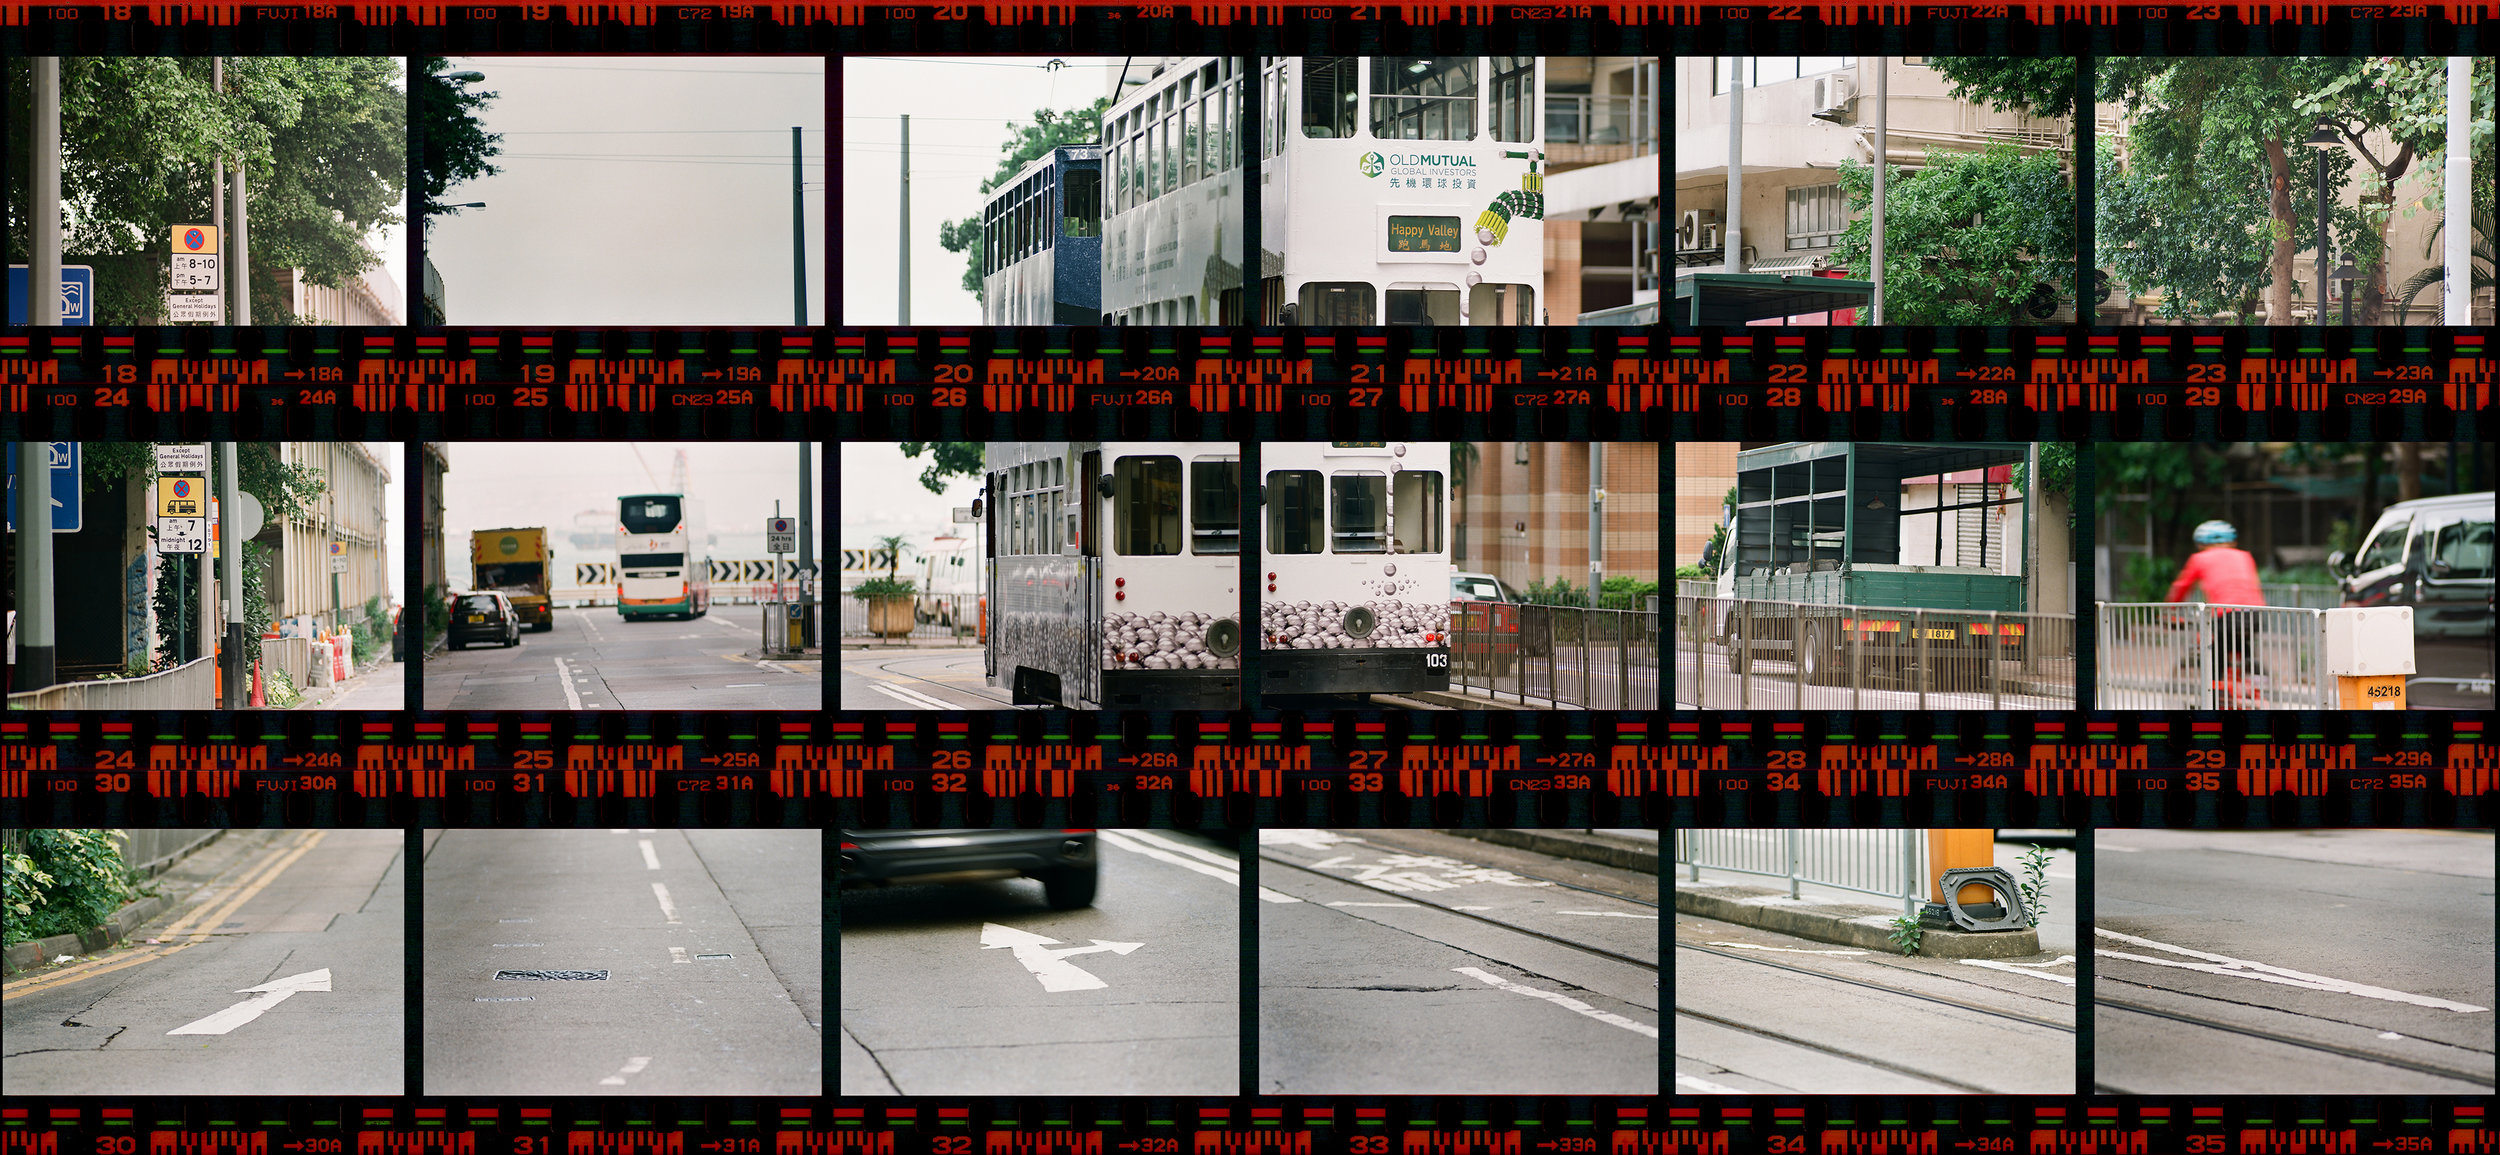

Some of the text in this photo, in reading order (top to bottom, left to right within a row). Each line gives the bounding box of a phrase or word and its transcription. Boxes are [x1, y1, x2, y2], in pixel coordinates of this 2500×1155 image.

[49, 8, 78, 20] 100
[100, 3, 131, 20] 18
[257, 4, 337, 19] FUJI 18A
[467, 8, 496, 19] 100
[519, 3, 549, 20] 19
[679, 4, 754, 19] C72 19A
[886, 8, 915, 19] 100
[933, 3, 968, 20] 20
[1137, 4, 1173, 18] 20A
[1303, 8, 1332, 19] 100
[1350, 3, 1381, 20] 21
[1511, 4, 1591, 19] CN23 21A
[1720, 8, 1749, 19] 100
[1768, 3, 1802, 20] 22
[1928, 4, 2008, 19] FUJI 22A
[2139, 8, 2167, 19] 100
[2186, 3, 2220, 20] 23
[2351, 4, 2427, 18] C72 23A
[1071, 149, 1088, 160] 73
[1390, 154, 1476, 167] OLDMUTUAL
[1430, 168, 1476, 176] INVESTORS
[1390, 177, 1476, 189] 先機環球投資
[1392, 224, 1459, 239] Happy Valley
[1398, 239, 1453, 251] 跑馬地
[189, 259, 216, 269] 8-10
[102, 365, 136, 383] 18
[309, 367, 342, 381] 18A
[521, 365, 554, 384] 19
[727, 367, 761, 381] 19A
[934, 364, 973, 383] 20
[1142, 367, 1179, 380] 20A
[1351, 364, 1384, 383] 21
[1559, 367, 1596, 380] 21A
[1768, 364, 1807, 383] 22
[1978, 366, 2015, 380] 22A
[2187, 364, 2226, 383] 23
[2395, 366, 2432, 380] 23A
[47, 394, 76, 406] 100
[95, 388, 129, 407] 24
[300, 390, 336, 404] 24A
[465, 394, 495, 405] 100
[513, 388, 548, 406] 25
[672, 390, 753, 405] CN23 25A
[884, 394, 914, 405] 100
[932, 387, 967, 406] 26
[1091, 390, 1172, 405] FUJI 26A
[1302, 394, 1330, 406] 100
[1349, 388, 1383, 407] 27
[1515, 390, 1590, 406] C72 27A
[1719, 394, 1748, 405] 100
[1767, 387, 1801, 406] 28
[1970, 389, 2007, 404] 28A
[2138, 394, 2167, 405] 100
[2185, 387, 2220, 406] 29
[2345, 389, 2426, 405] CN23 29A
[187, 520, 196, 532] 7
[188, 539, 202, 551] 12
[1425, 653, 1448, 668] 103
[2368, 686, 2401, 697] 45218
[96, 750, 135, 769] 24
[305, 753, 341, 767] 24A
[514, 750, 553, 769] 25
[723, 753, 759, 767] 25A
[932, 750, 971, 770] 26
[1141, 753, 1177, 767] 26A
[1349, 751, 1388, 770] 27
[1559, 753, 1595, 767] 27A
[1767, 751, 1806, 770] 28
[1977, 752, 2014, 767] 28A
[2186, 750, 2225, 770] 29
[2395, 752, 2432, 766] 29A
[48, 780, 77, 791] 100
[96, 773, 130, 792] 30
[257, 776, 336, 791] FUJI 30A
[466, 780, 495, 791] 100
[514, 773, 544, 792] 31
[678, 776, 753, 791] C72 31A
[884, 780, 914, 791] 100
[932, 773, 966, 792] 32
[1136, 775, 1172, 790] 32A
[1302, 780, 1331, 790] 100
[1349, 773, 1383, 792] 33
[1510, 775, 1590, 790] CN23 33A
[1719, 779, 1748, 790] 100
[1767, 772, 1800, 791] 34
[1927, 774, 2007, 790] FUJI 34A
[2138, 779, 2167, 790] 100
[2186, 772, 2220, 791] 35
[2350, 774, 2426, 789] C72 35A
[96, 1136, 136, 1154] 30
[306, 1138, 341, 1152] 30A
[514, 1136, 548, 1154] 31
[724, 1139, 760, 1152] 31A
[933, 1136, 971, 1154] 32
[1141, 1138, 1178, 1152] 32A
[1350, 1136, 1389, 1154] 33
[1560, 1138, 1596, 1152] 33A
[1768, 1135, 1806, 1153] 34
[1977, 1137, 2014, 1151] 34A
[2186, 1135, 2225, 1153] 35
[2395, 1137, 2432, 1150] 35A
